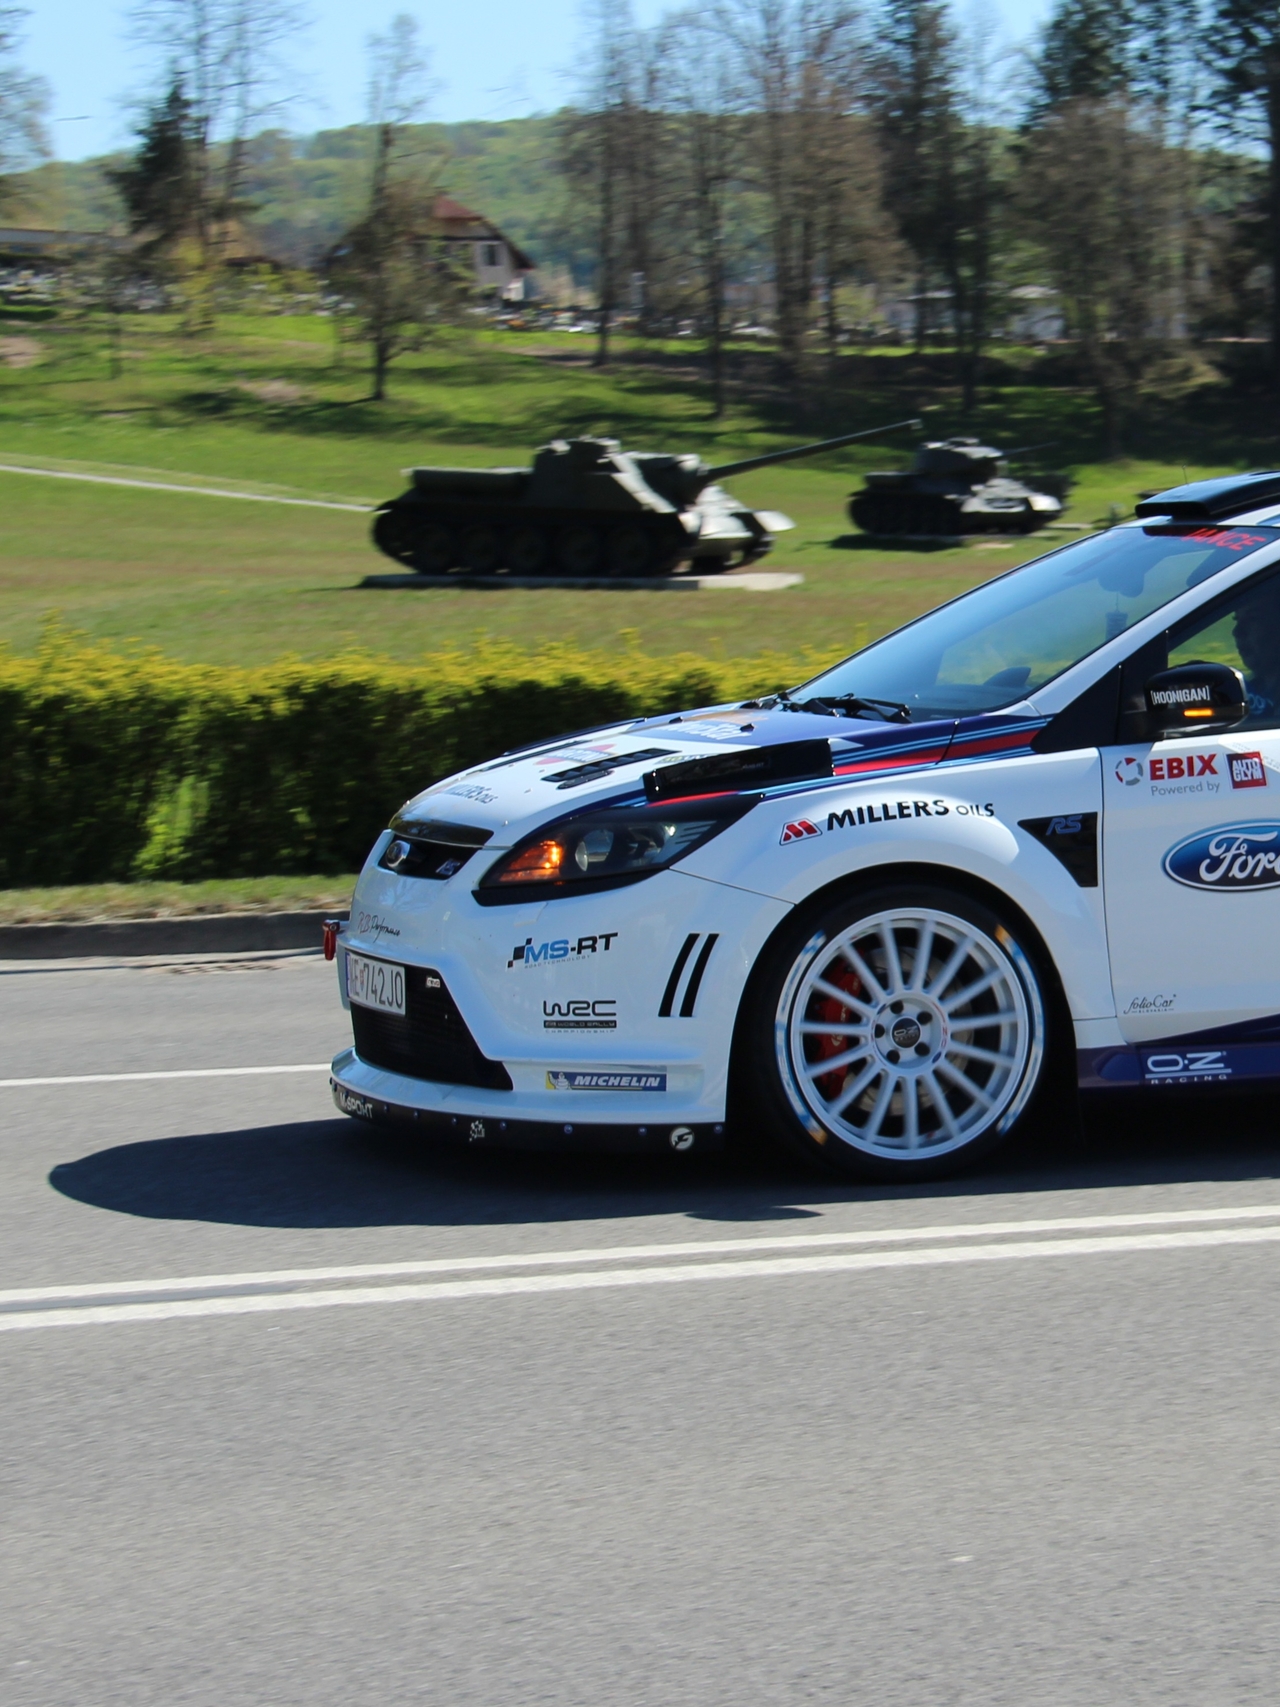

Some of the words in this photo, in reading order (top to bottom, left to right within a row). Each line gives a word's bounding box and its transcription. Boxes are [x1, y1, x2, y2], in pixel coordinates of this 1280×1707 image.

[1149, 753, 1218, 781] EBIX
[1150, 784, 1204, 797] Powered
[1206, 780, 1221, 793] by
[826, 799, 950, 831] MILLERS
[955, 803, 995, 817] OILS
[1046, 815, 1083, 836] RS
[524, 932, 618, 964] MS-RT
[363, 963, 404, 1011] 742JO
[543, 1000, 617, 1017] WRC
[574, 1075, 661, 1087] MICHELIN
[1151, 1074, 1227, 1085] RACING
